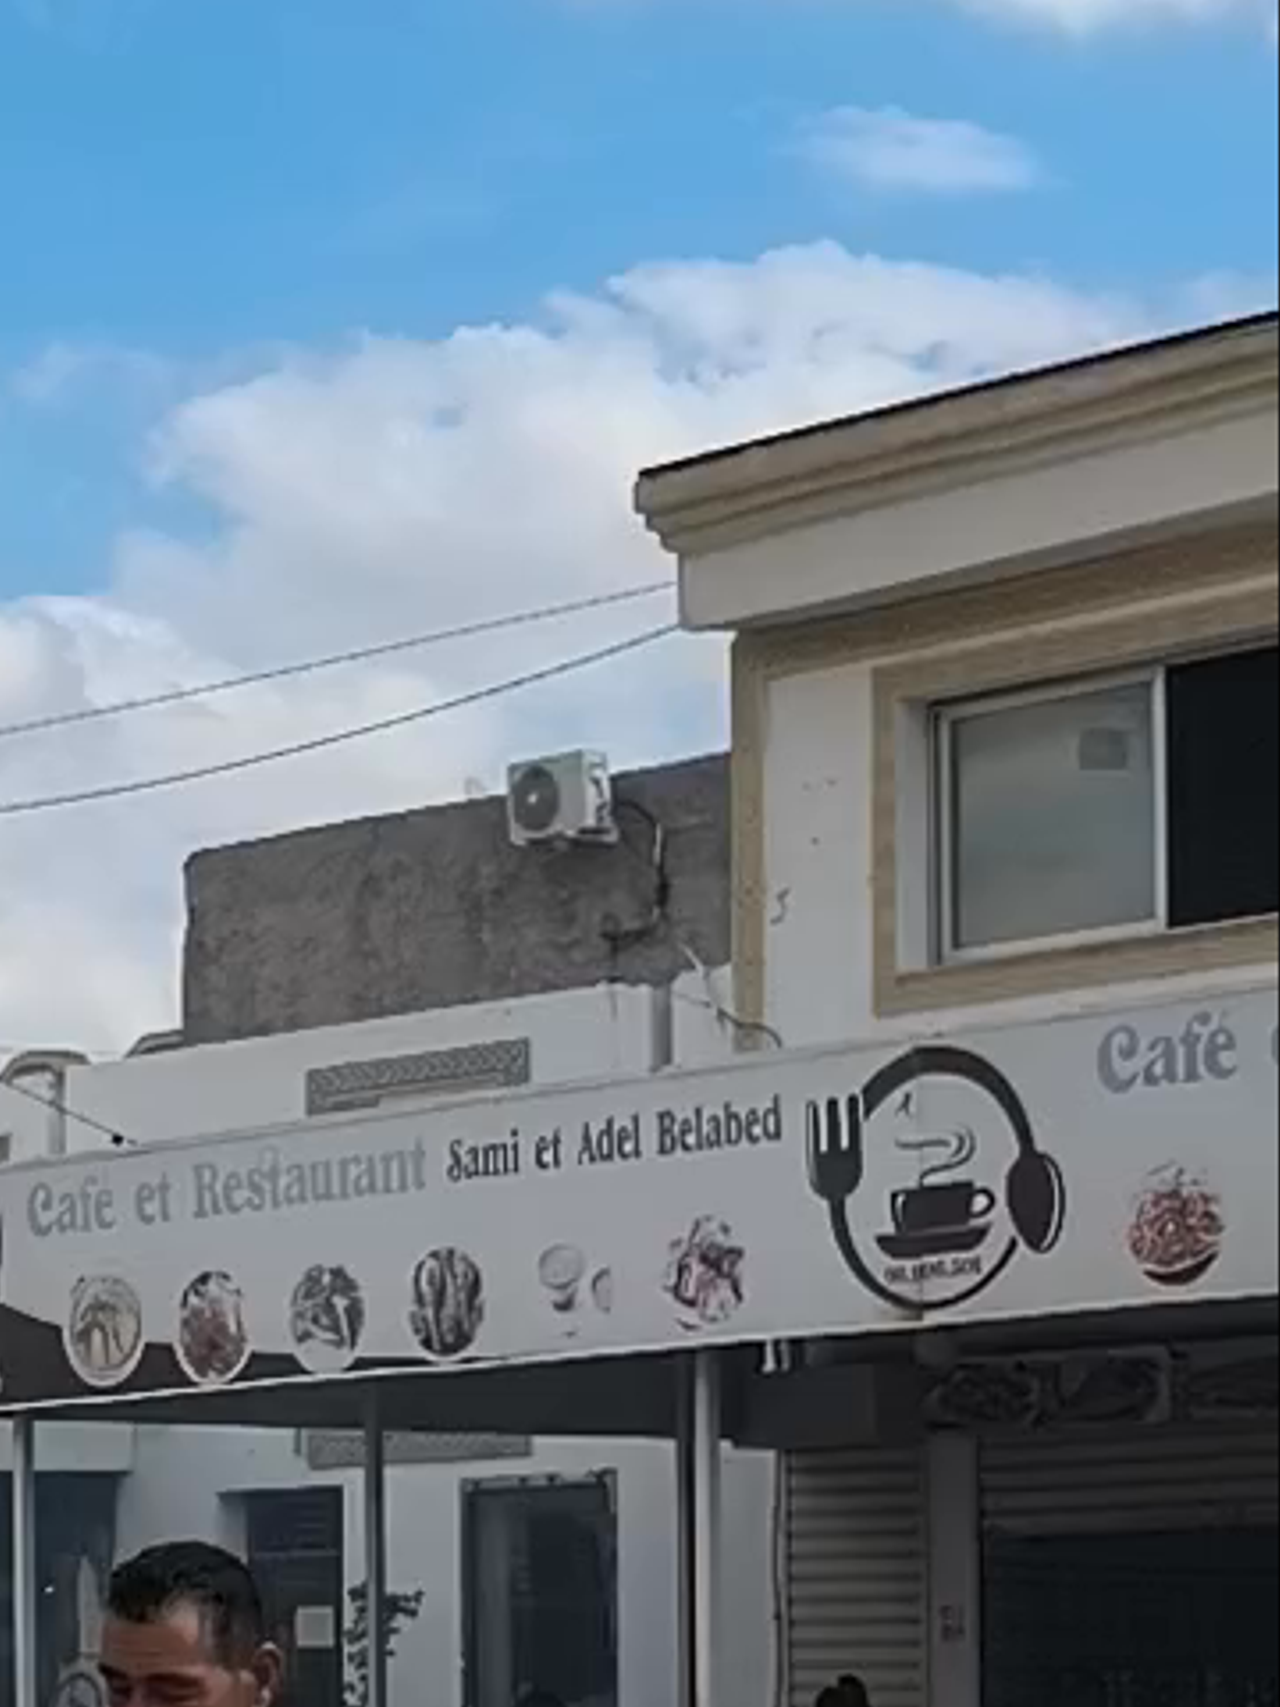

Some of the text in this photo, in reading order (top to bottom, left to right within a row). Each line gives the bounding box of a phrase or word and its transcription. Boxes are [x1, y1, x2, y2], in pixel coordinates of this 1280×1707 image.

[1097, 1009, 1238, 1094] Café
[28, 1094, 782, 1236] Café et Restaurant Sami et Adel Belabed
